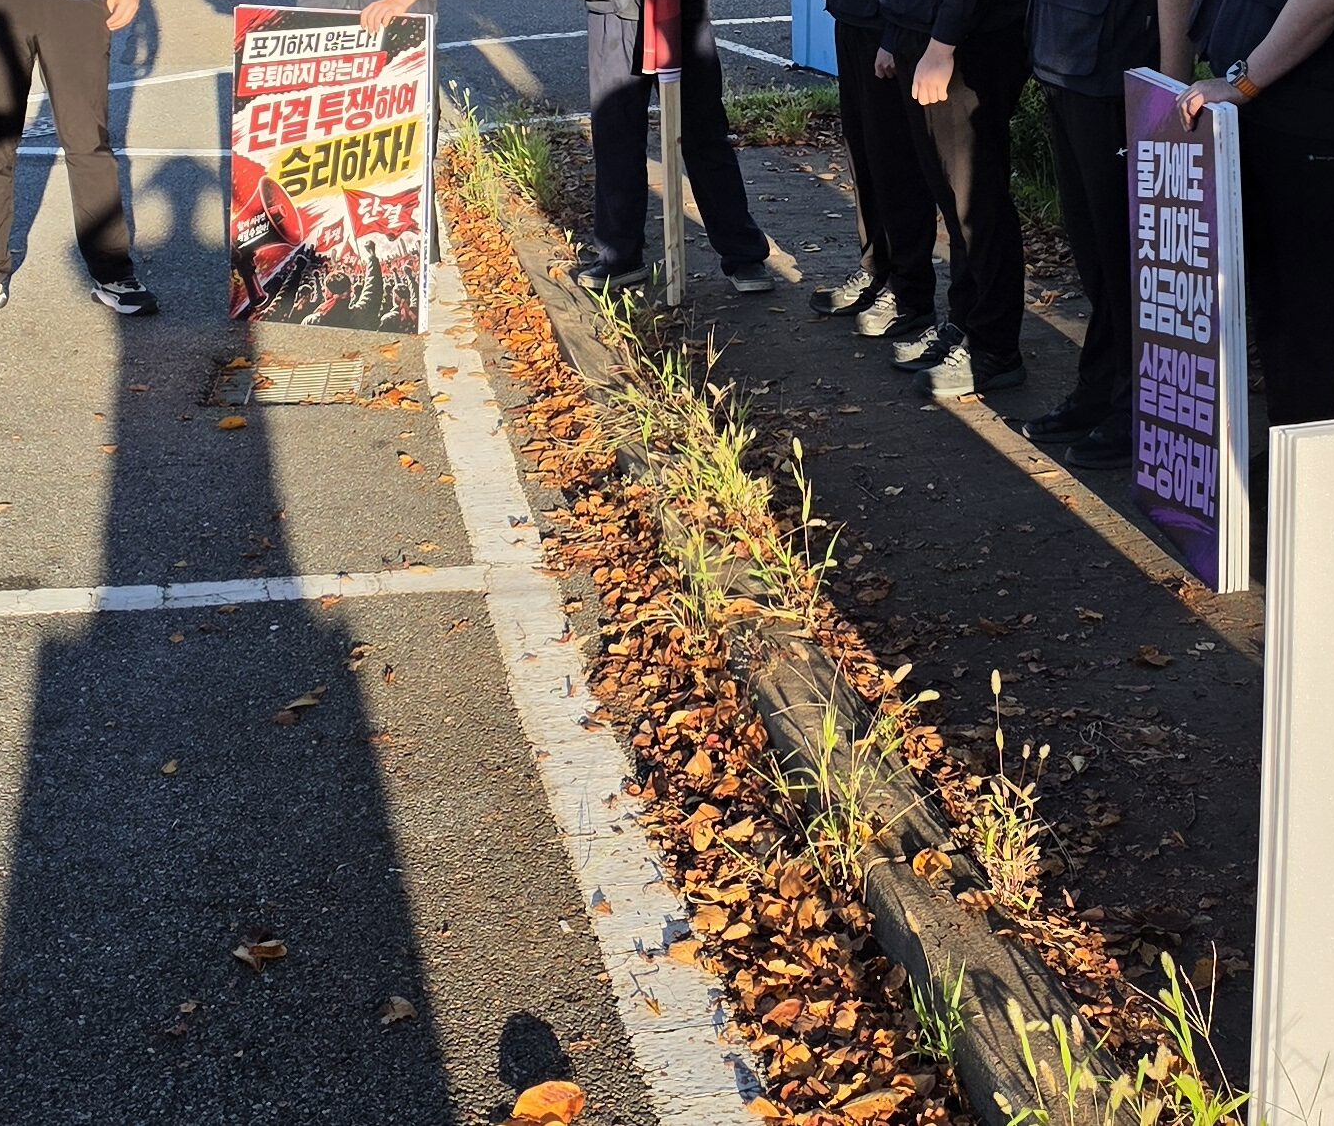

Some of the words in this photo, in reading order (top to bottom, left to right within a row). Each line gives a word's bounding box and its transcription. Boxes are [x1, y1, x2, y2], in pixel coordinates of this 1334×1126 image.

[245, 61, 316, 90] 후퇴하지
[318, 55, 378, 82] 않는다!
[249, 32, 320, 59] 포기하지
[323, 28, 378, 52] 않는다!
[248, 96, 312, 152] 단결
[315, 80, 418, 136] 투쟁하여
[279, 121, 417, 198] 승리하자!
[1137, 140, 1204, 202] 물가에도
[357, 196, 406, 228] 단결
[1138, 204, 1156, 261] 못
[1159, 206, 1210, 269] 미치는
[1139, 265, 1213, 344] 임금인상
[1139, 342, 1215, 436] 실질임금
[1137, 420, 1218, 518] 보장하라!
